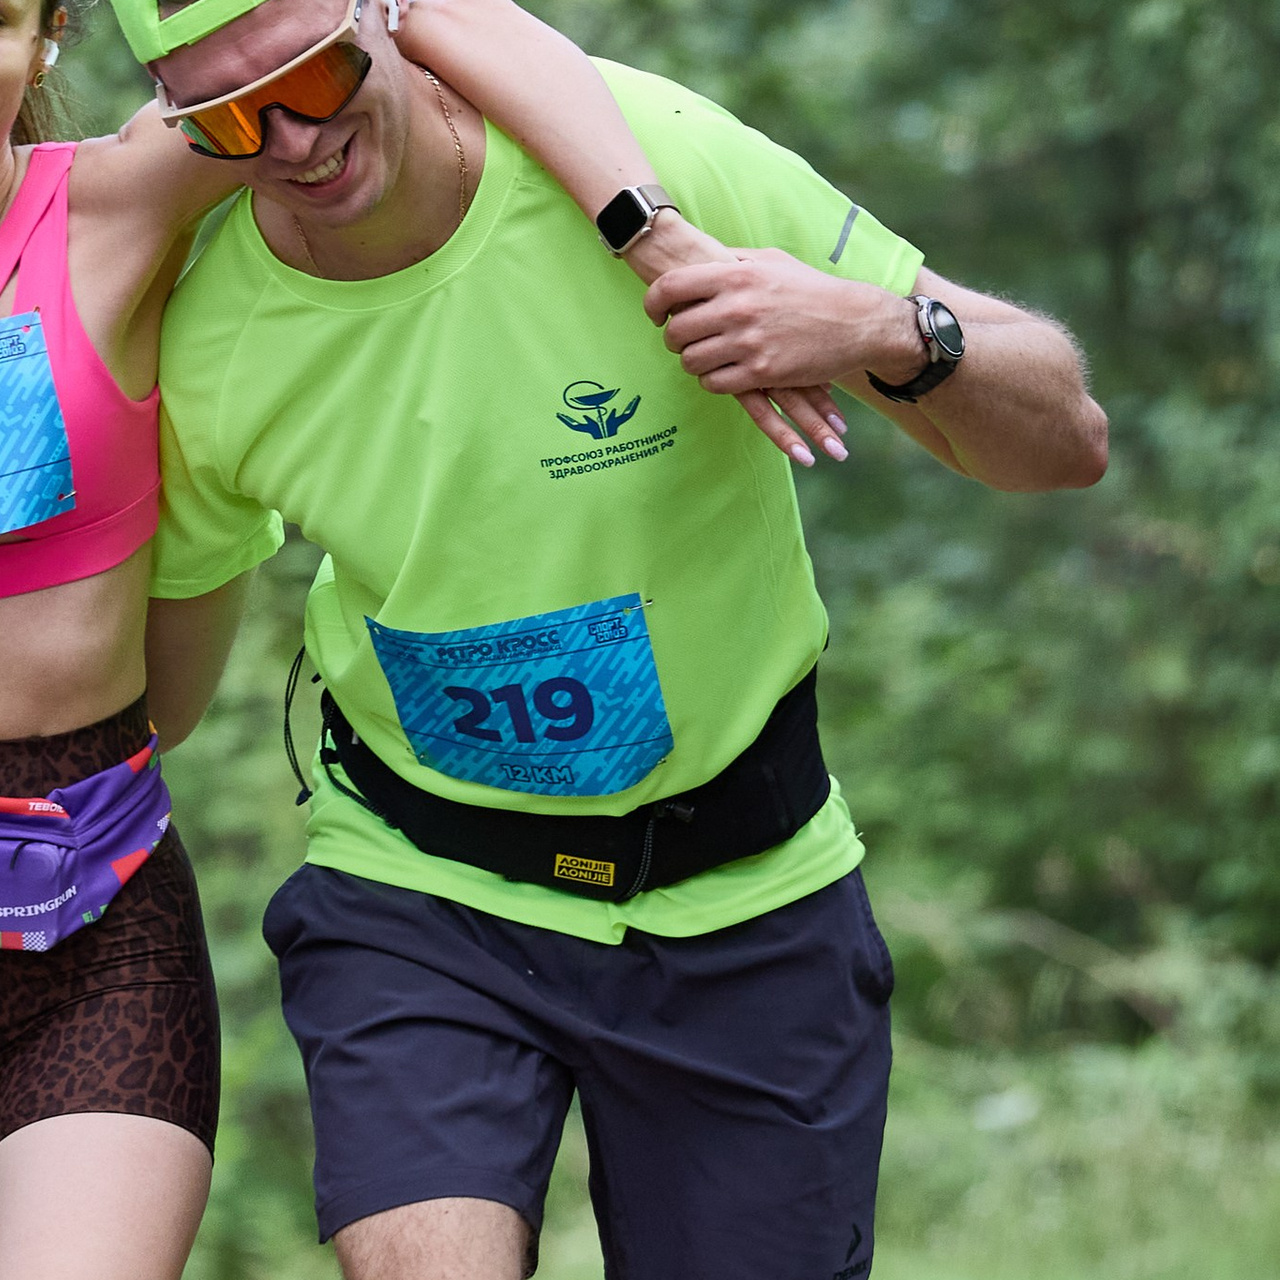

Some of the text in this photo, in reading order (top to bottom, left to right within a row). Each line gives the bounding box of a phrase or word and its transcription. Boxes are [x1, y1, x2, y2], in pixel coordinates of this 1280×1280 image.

[540, 425, 678, 468] ПРОФСОЮЗ РАБОТНИКОВ
[549, 439, 675, 480] ЗДРАВООХРАНЕНИЯ РФ
[437, 643, 493, 660] РЕТРО
[496, 630, 560, 654] КРОСС
[443, 677, 595, 743] 219
[500, 763, 531, 782] 12
[559, 868, 610, 882] AONIJIE
[560, 857, 611, 872] AONIJIE
